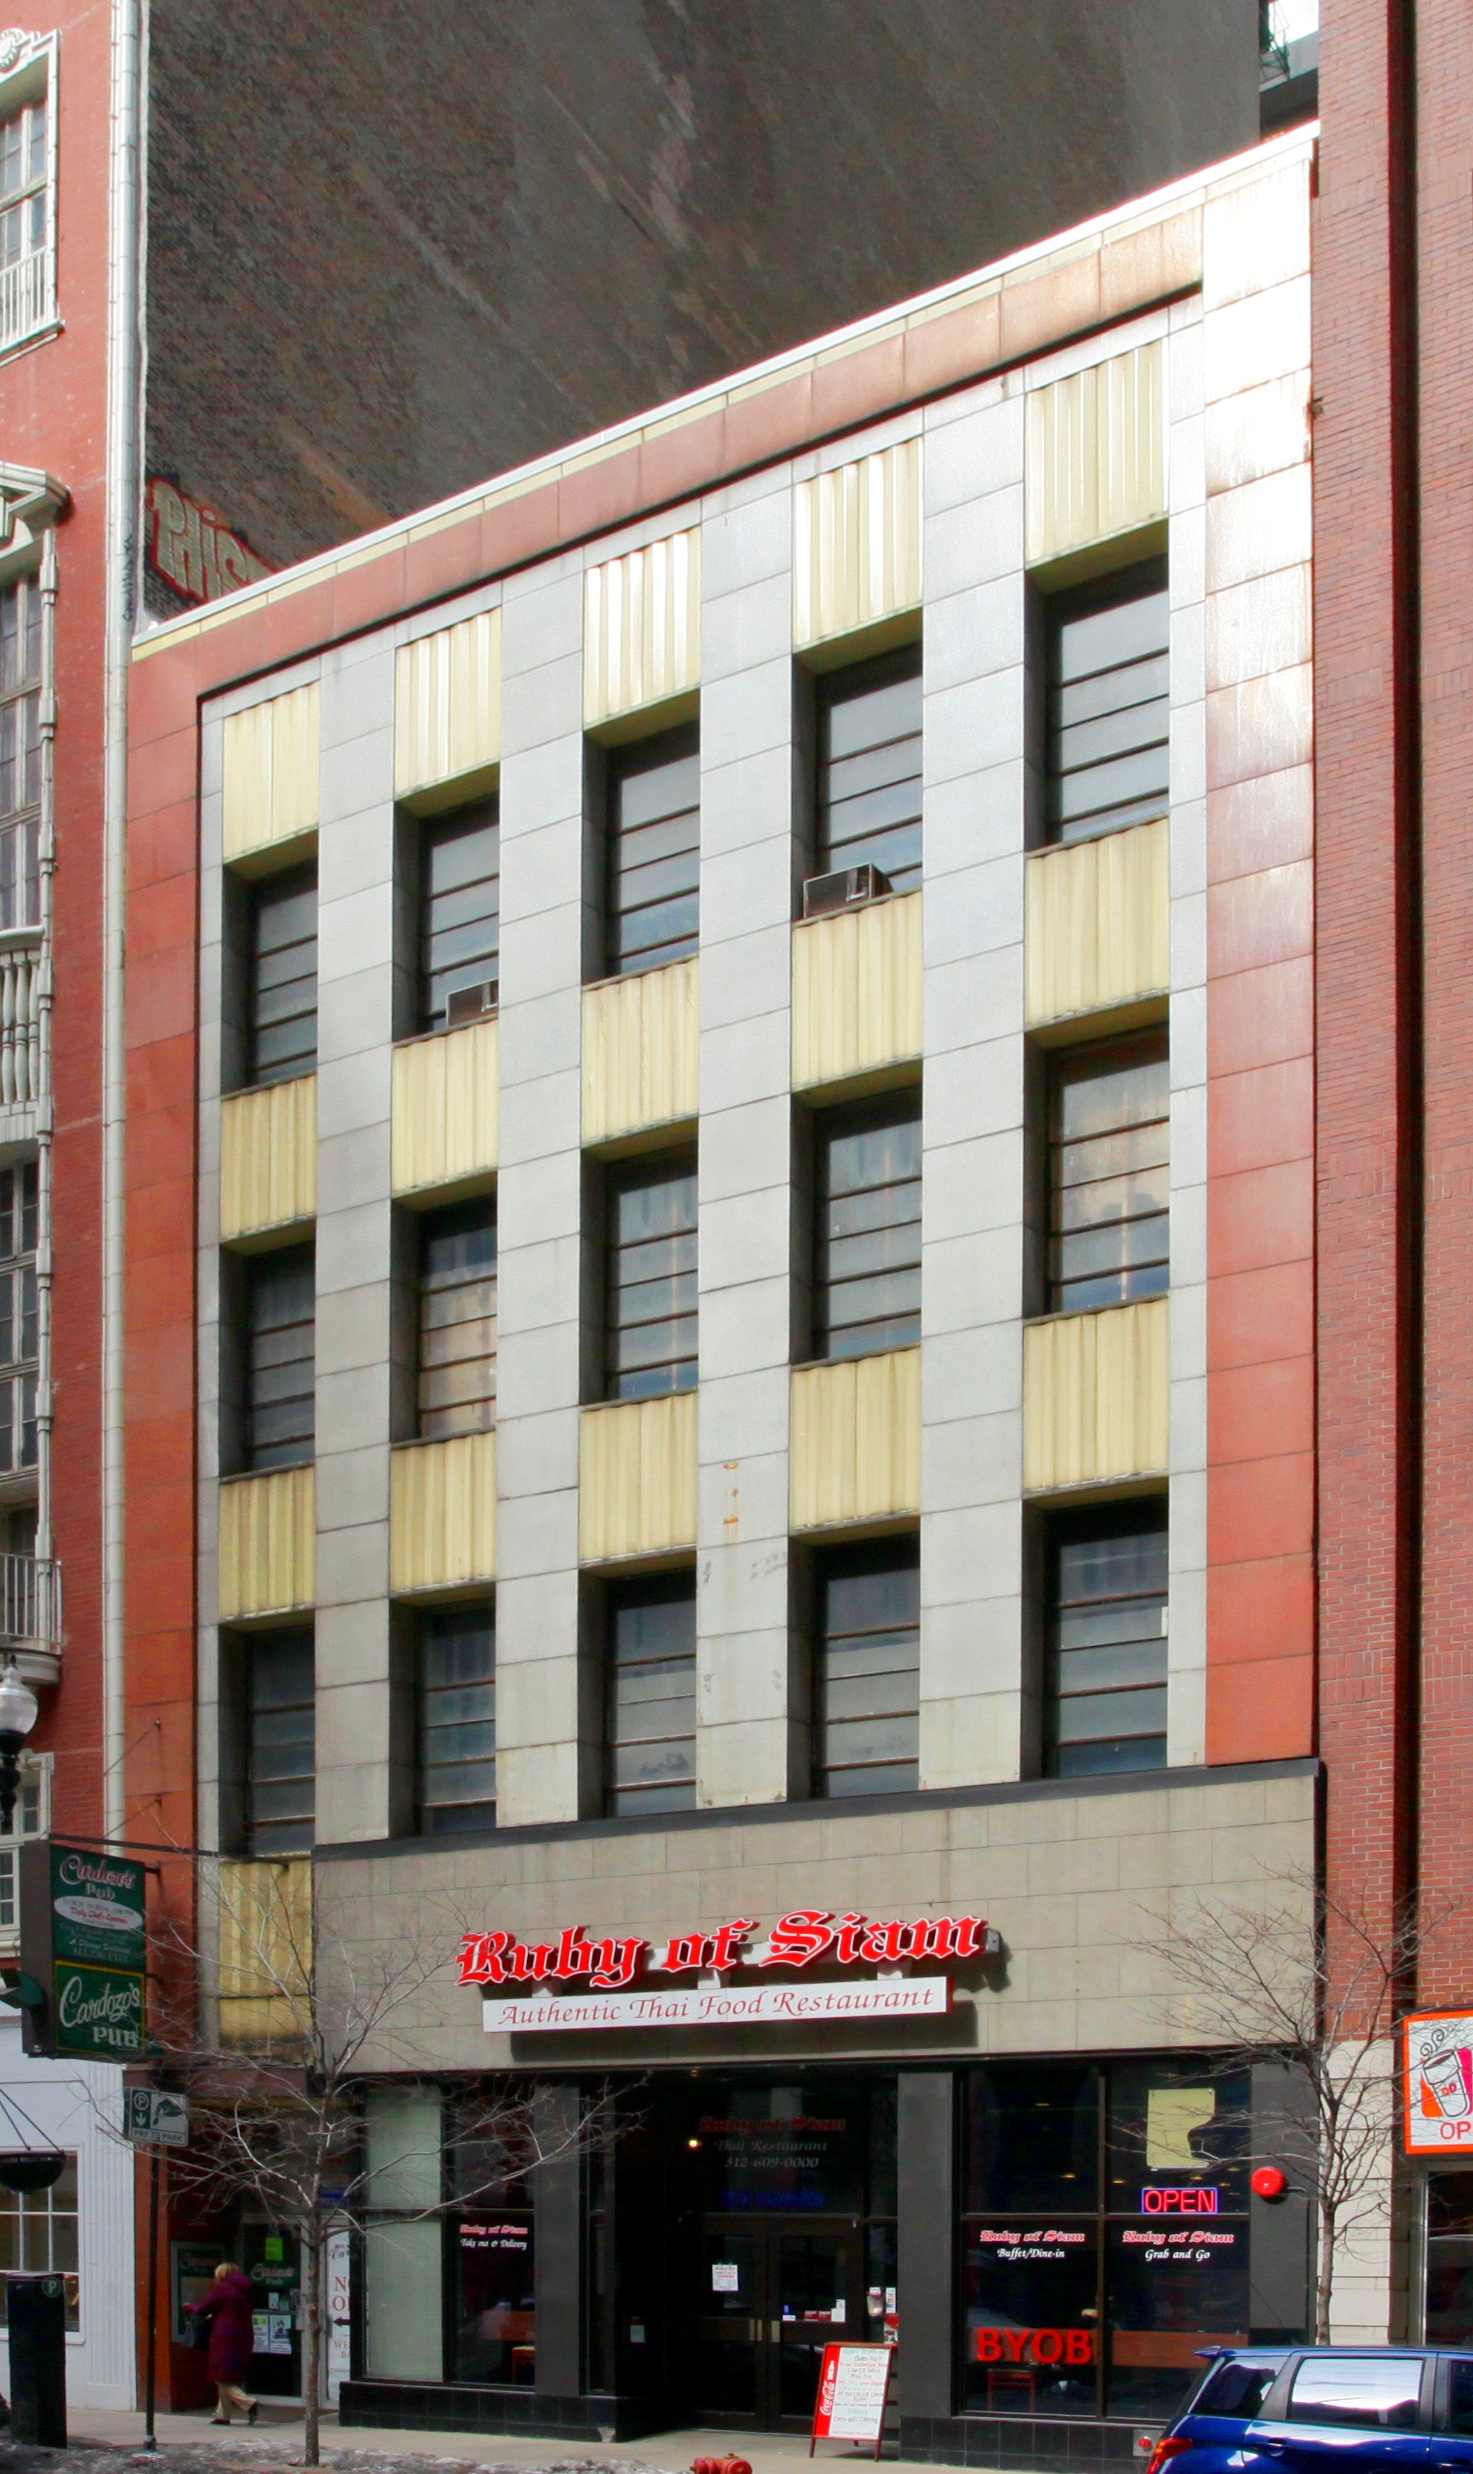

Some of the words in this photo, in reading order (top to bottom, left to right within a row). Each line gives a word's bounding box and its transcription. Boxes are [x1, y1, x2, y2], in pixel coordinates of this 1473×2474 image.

[85, 1883, 116, 1901] Pub
[454, 1925, 652, 1988] Ruby
[662, 1918, 761, 1974] of
[758, 1909, 986, 1968] Siam
[59, 1976, 140, 2028] Cardozo's
[497, 2000, 621, 2026] Authentic
[629, 1996, 690, 2020] Thai
[697, 1994, 764, 2020] Food
[772, 1988, 935, 2016] Restaurant
[151, 2131, 161, 2139] TO
[162, 2132, 183, 2142] PARK
[714, 2140, 745, 2151] Thai
[751, 2140, 829, 2151] Restaurant
[724, 2156, 820, 2168] 312-609-0000
[1144, 2190, 1215, 2213] OPEN
[980, 2230, 1021, 2244] Ruby
[1023, 2230, 1040, 2242] of
[1043, 2230, 1086, 2243] Siam
[1122, 2230, 1165, 2245] Ruby
[1168, 2231, 1188, 2243] of
[1189, 2231, 1235, 2244] Siam
[500, 2239, 528, 2251] Delivery
[997, 2248, 1066, 2261] Buffet/Dine-in
[1145, 2249, 1170, 2261] Grab
[1173, 2249, 1191, 2259] and
[1195, 2249, 1211, 2260] Go
[977, 2328, 1092, 2365] BYOB
